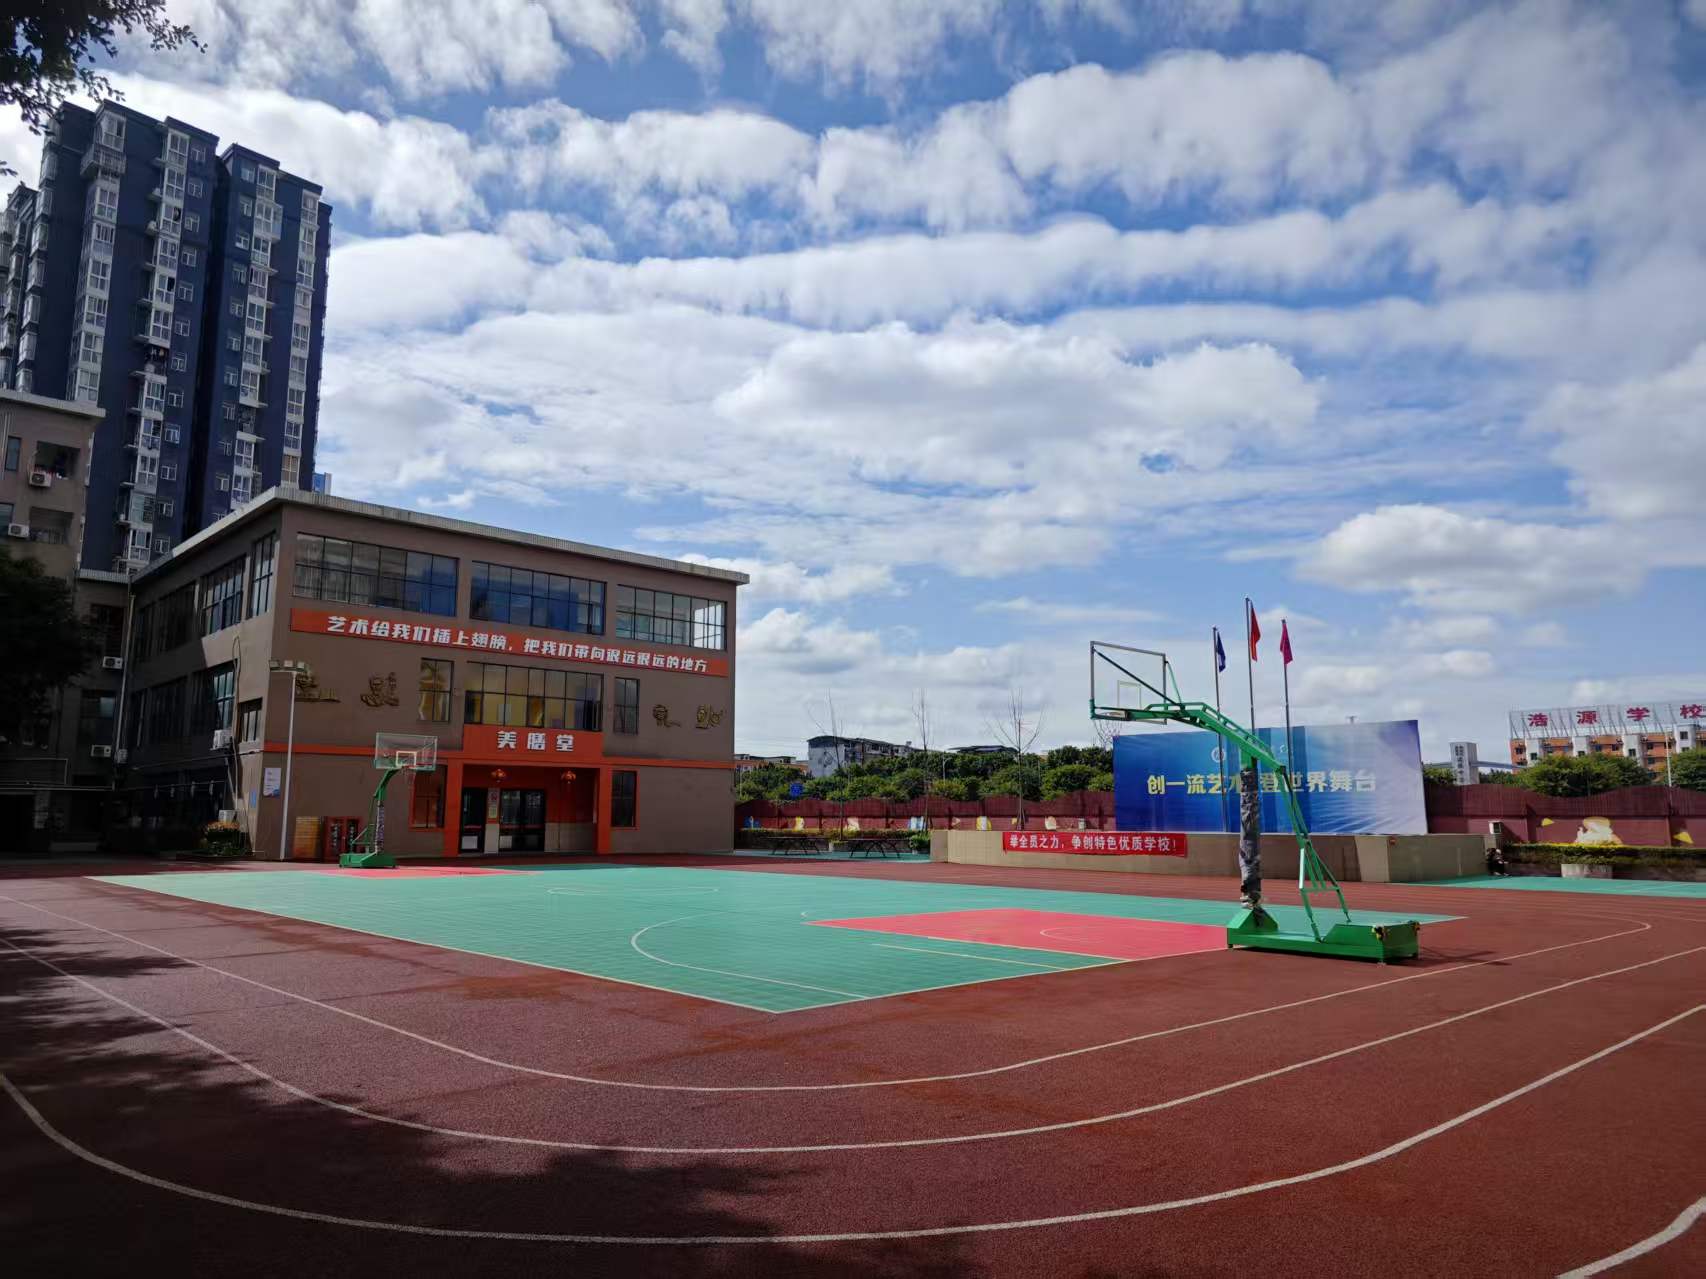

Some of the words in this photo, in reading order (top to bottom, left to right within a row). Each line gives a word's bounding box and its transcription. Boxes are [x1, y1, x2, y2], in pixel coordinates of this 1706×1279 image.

[1527, 704, 1706, 727] 浩源学校
[497, 730, 575, 752] 美膳堂
